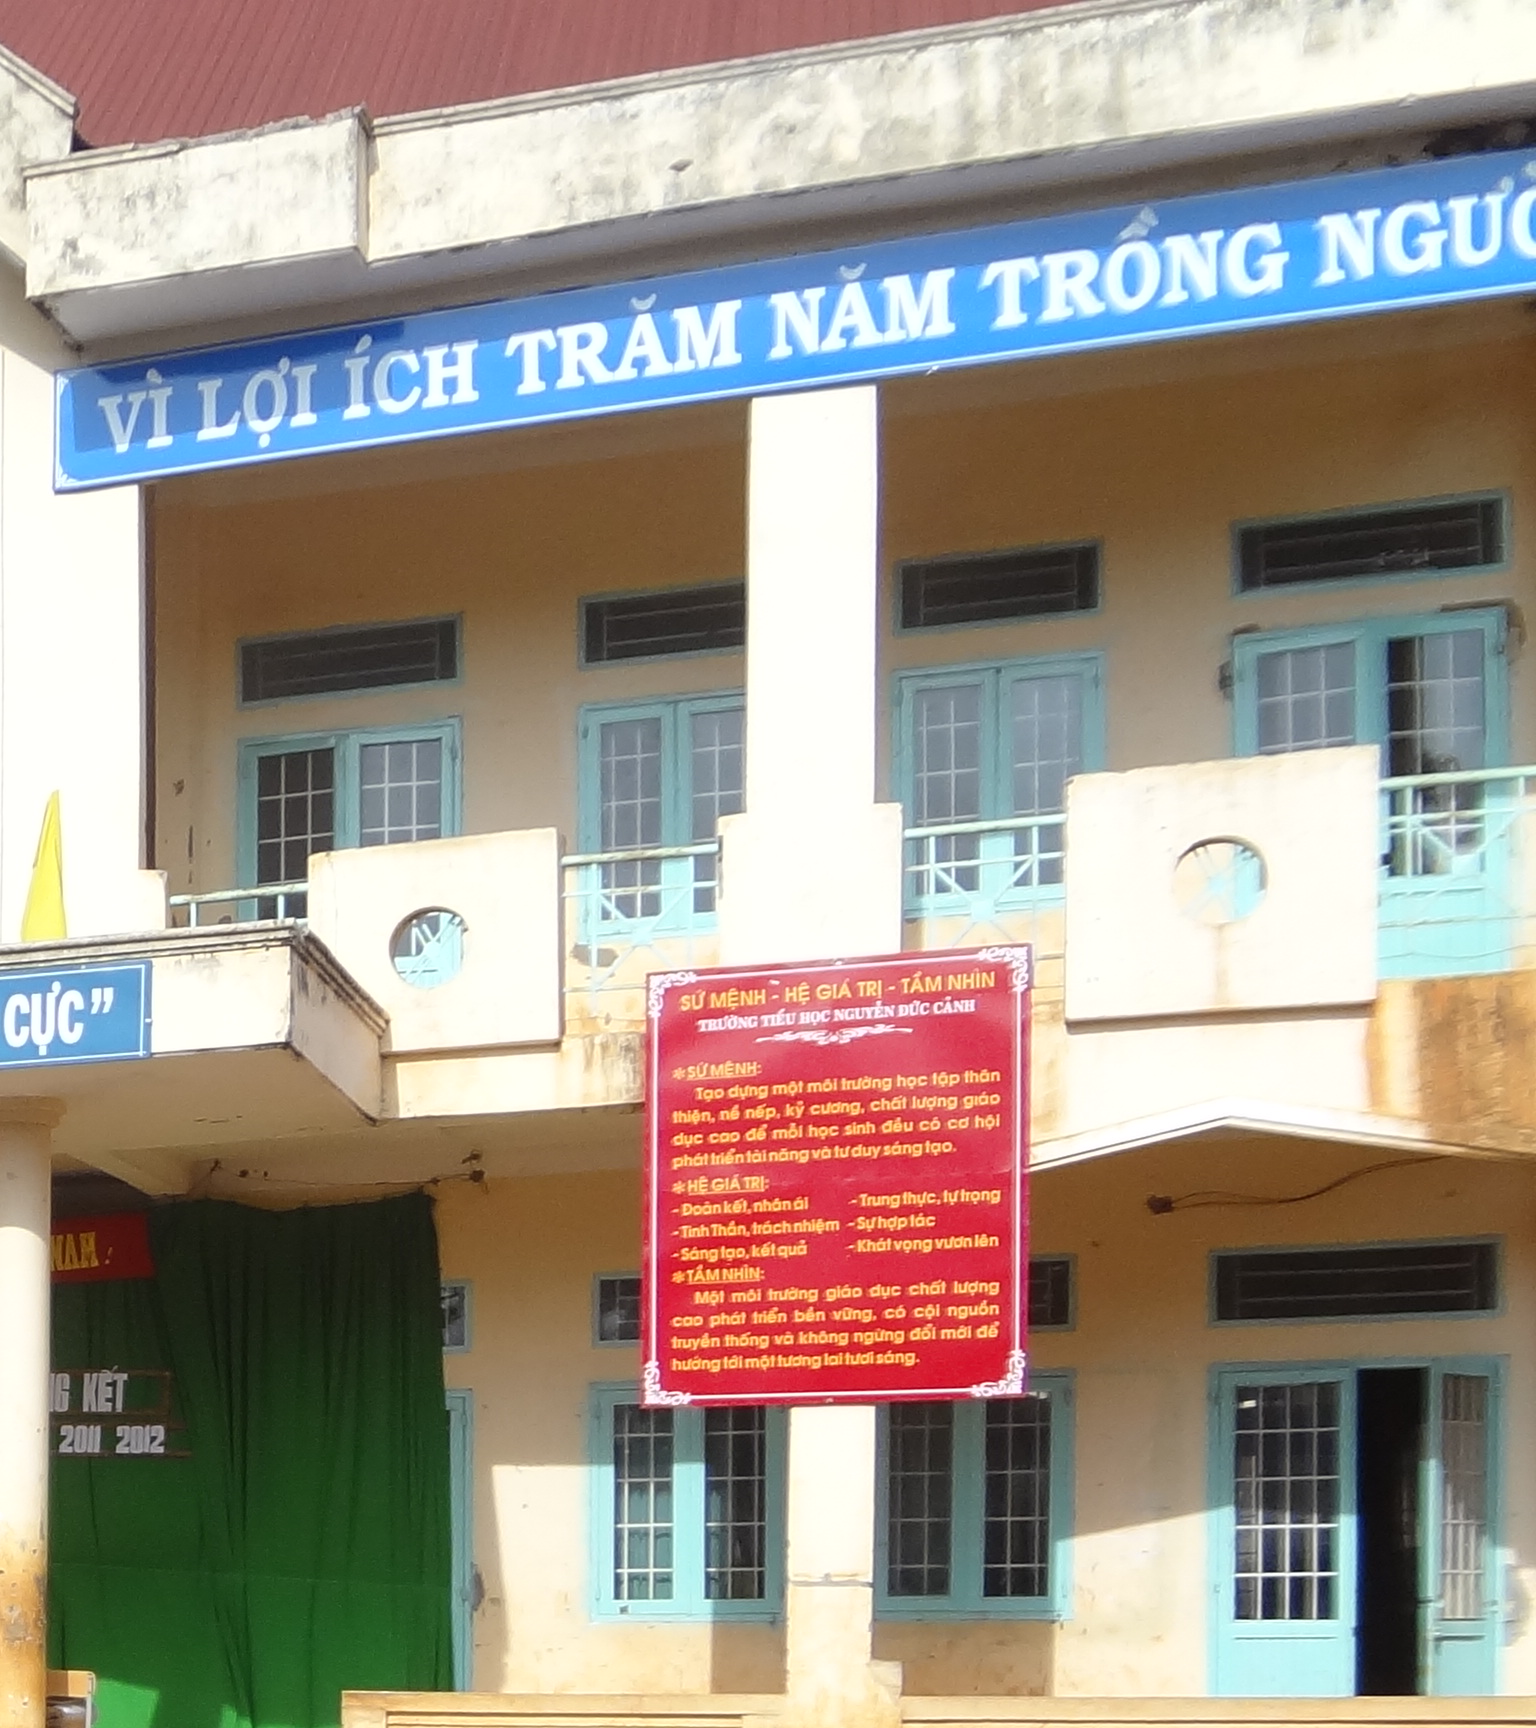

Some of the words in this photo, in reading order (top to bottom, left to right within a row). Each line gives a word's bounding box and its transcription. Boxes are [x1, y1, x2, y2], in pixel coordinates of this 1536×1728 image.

[98, 368, 174, 453] VÌ
[197, 357, 319, 448] LỢI
[343, 334, 479, 421] ÍCH
[505, 293, 742, 396] TRĂM
[767, 261, 956, 360] NĂM
[978, 206, 1290, 329] TRỒNG
[680, 990, 705, 1012] SỨ
[710, 988, 766, 1009] MỆNH
[785, 982, 811, 1005] HỆ
[816, 979, 851, 1000] GIÁ
[857, 980, 882, 998] TRỊ
[901, 972, 941, 994] TẦM
[948, 969, 995, 990] NHÌN
[697, 1015, 758, 1032] TRƯỜNG
[761, 1010, 797, 1027] TIỂU
[800, 1009, 831, 1026] HỌC
[834, 1002, 894, 1022] NGUYỄN
[897, 1000, 930, 1017] ĐỨC
[933, 996, 976, 1014] CẢNH
[695, 1087, 724, 1102] Tạo
[728, 1084, 768, 1099] dựng
[773, 1081, 804, 1096] một
[807, 1078, 837, 1092] môi
[841, 1076, 892, 1091] trường
[897, 1074, 928, 1089] học
[932, 1072, 960, 1087] tập
[964, 1069, 1001, 1083] thân
[870, 1095, 907, 1111] chất
[912, 1096, 958, 1111] lượng
[963, 1091, 1001, 1109] giáo
[672, 1132, 704, 1148] dục
[709, 1131, 740, 1143] cao
[745, 1124, 768, 1141] để
[772, 1123, 803, 1139] mỗi
[808, 1124, 839, 1140] học
[844, 1121, 876, 1135] sinh
[881, 1117, 914, 1133] đều
[919, 1117, 941, 1131] có
[947, 1117, 969, 1130] cơ
[975, 1114, 1000, 1130] hội
[671, 1153, 708, 1170] phát
[711, 1148, 744, 1165] triển
[747, 1150, 767, 1163] tài
[768, 1148, 809, 1164] năng
[812, 1146, 831, 1159] và
[834, 1145, 851, 1158] tư
[851, 1144, 881, 1159] duy
[883, 1141, 923, 1157] sáng
[712, 1174, 741, 1191] GIÁ
[681, 1201, 721, 1216] Đoàn
[754, 1198, 791, 1212] nhân
[793, 1196, 809, 1210] ái
[859, 1193, 900, 1208] Trung
[943, 1189, 959, 1205] tự
[961, 1189, 1001, 1205] trọng
[752, 1221, 792, 1235] trách
[794, 1218, 840, 1234] nhiệm
[856, 1216, 876, 1232] Sự
[878, 1216, 908, 1231] hợp
[910, 1213, 936, 1227] tác
[680, 1246, 719, 1262] Sáng
[752, 1241, 776, 1257] kết
[778, 1240, 808, 1258] quả
[857, 1237, 891, 1252] Khát
[894, 1238, 932, 1253] vọng
[935, 1236, 973, 1249] vươn
[974, 1234, 999, 1247] lên
[694, 1290, 725, 1306] Một
[731, 1288, 761, 1303] môi
[768, 1287, 818, 1302] trường
[824, 1284, 863, 1301] giáo
[869, 1284, 901, 1300] dục
[909, 1279, 946, 1296] chất
[953, 1281, 1000, 1296] lượng
[670, 1315, 704, 1327] cao
[709, 1311, 746, 1328] phát
[752, 1307, 787, 1323] triển
[794, 1307, 826, 1322] bền
[884, 1305, 906, 1319] có
[914, 1303, 940, 1320] cội
[948, 1300, 1000, 1319] nguồn
[671, 1333, 720, 1350] truyền
[725, 1331, 770, 1349] thống
[774, 1331, 794, 1345] và
[799, 1330, 849, 1346] không
[854, 1328, 905, 1345] ngừng
[909, 1324, 936, 1340] đổi
[941, 1325, 972, 1339] mới
[976, 1321, 1000, 1338] để
[671, 1356, 721, 1373] hướng
[723, 1355, 743, 1369] tới
[745, 1355, 775, 1372] một
[777, 1355, 821, 1369] tương
[824, 1352, 842, 1365] lai
[845, 1351, 874, 1365] tươi
[876, 1350, 921, 1366] sáng.
[82, 1365, 128, 1413] KẾT
[58, 1425, 102, 1453] 2011
[115, 1425, 165, 1454] 2012
